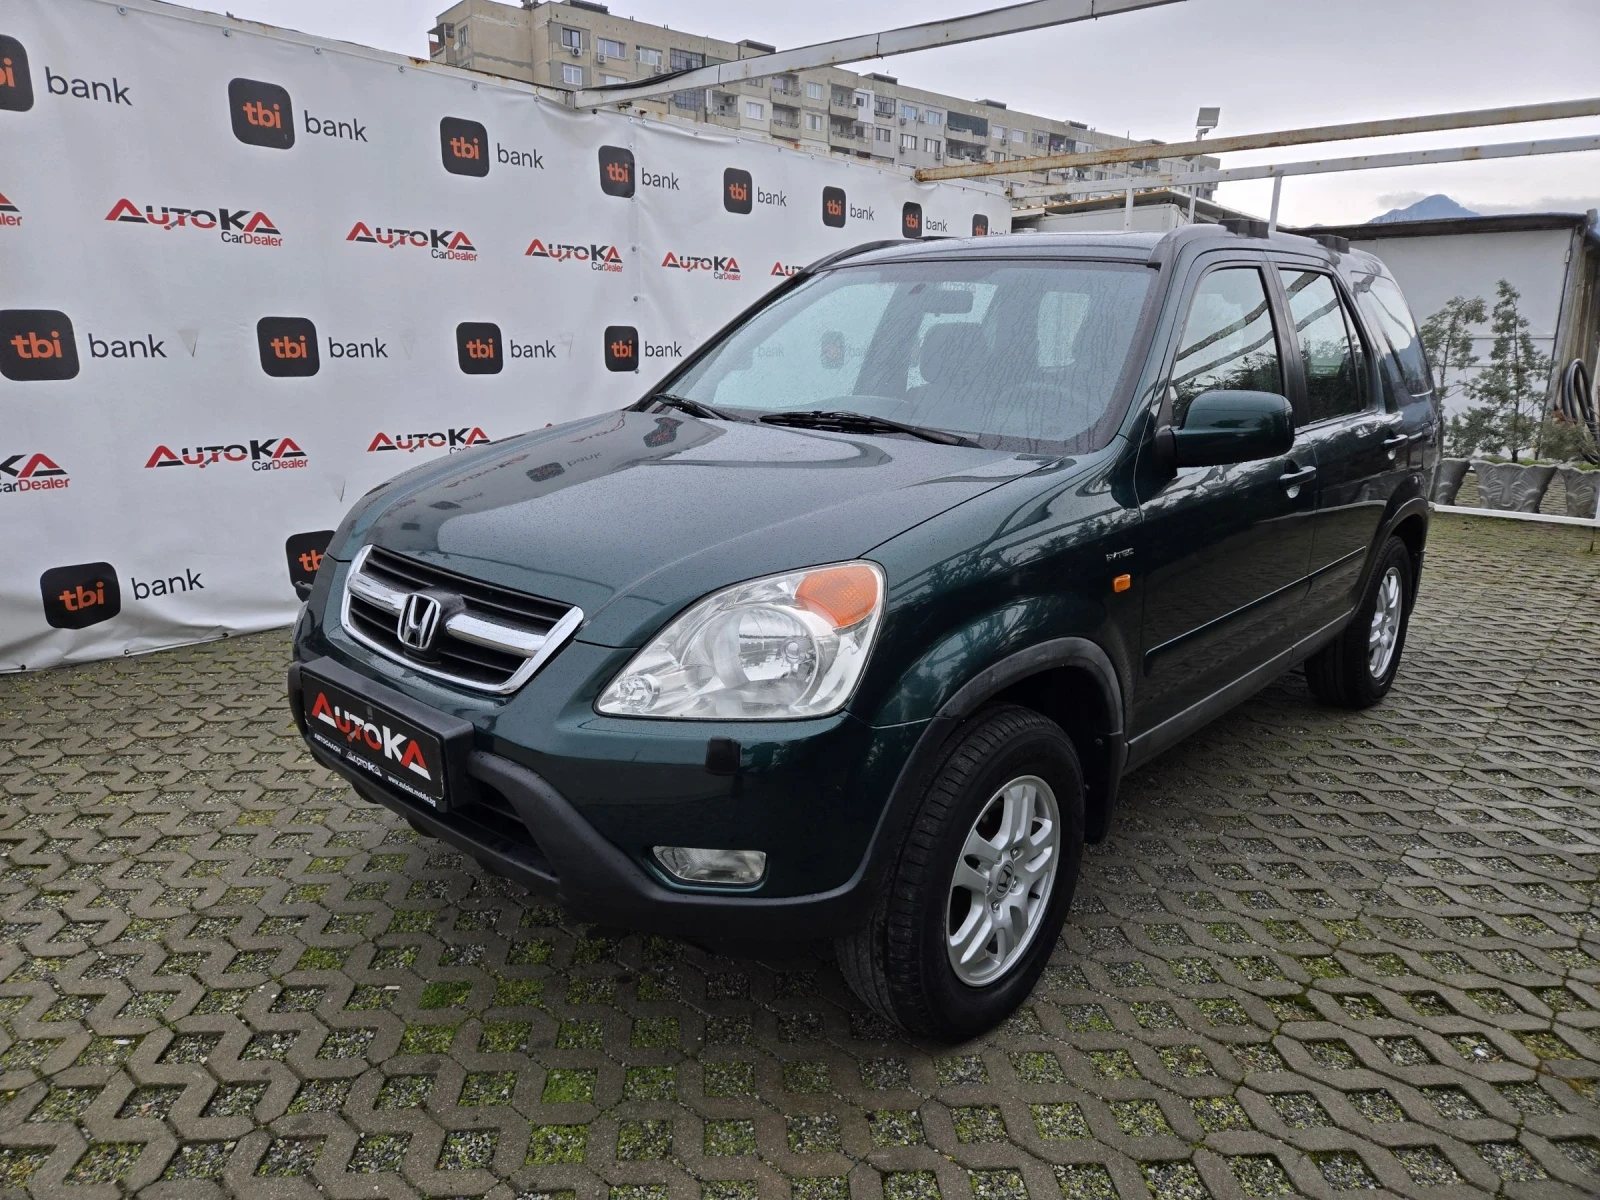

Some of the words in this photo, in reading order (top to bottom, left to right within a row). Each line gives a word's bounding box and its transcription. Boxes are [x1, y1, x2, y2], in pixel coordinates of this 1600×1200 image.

[45, 66, 133, 106] bank
[243, 101, 281, 129] tbi
[304, 110, 368, 142] bank
[450, 137, 480, 160] tbi
[497, 143, 544, 169] bank
[607, 162, 629, 183] tbi
[641, 168, 680, 191] bank
[729, 182, 747, 201] tbi
[757, 187, 787, 207] bank
[105, 198, 281, 235] AUTOKA
[827, 199, 842, 216] tbi
[850, 203, 875, 221] bank
[905, 213, 919, 229] tbi
[926, 216, 948, 233] bank
[221, 231, 283, 247] CarDealer
[346, 221, 477, 252] AUTOKA
[431, 249, 478, 262] CarDealer
[525, 238, 623, 264] AUTOKA
[661, 252, 741, 273] AUTOKA
[591, 261, 623, 273] CarDealer
[713, 271, 741, 281] CarDealer
[11, 331, 63, 359] tbi
[88, 333, 168, 358] bank
[270, 335, 307, 359] tbi
[328, 337, 389, 358] bank
[466, 338, 494, 359] tbi
[510, 340, 557, 358] bank
[611, 339, 633, 358] tbi
[645, 341, 682, 358] bank
[366, 427, 491, 453] AUTOKA
[144, 438, 307, 469] AUTOKA
[252, 458, 308, 471] CarDealer
[299, 550, 324, 571] tb
[59, 582, 105, 612] tbi
[131, 569, 204, 600] bank
[312, 692, 431, 780] AUTOKA
